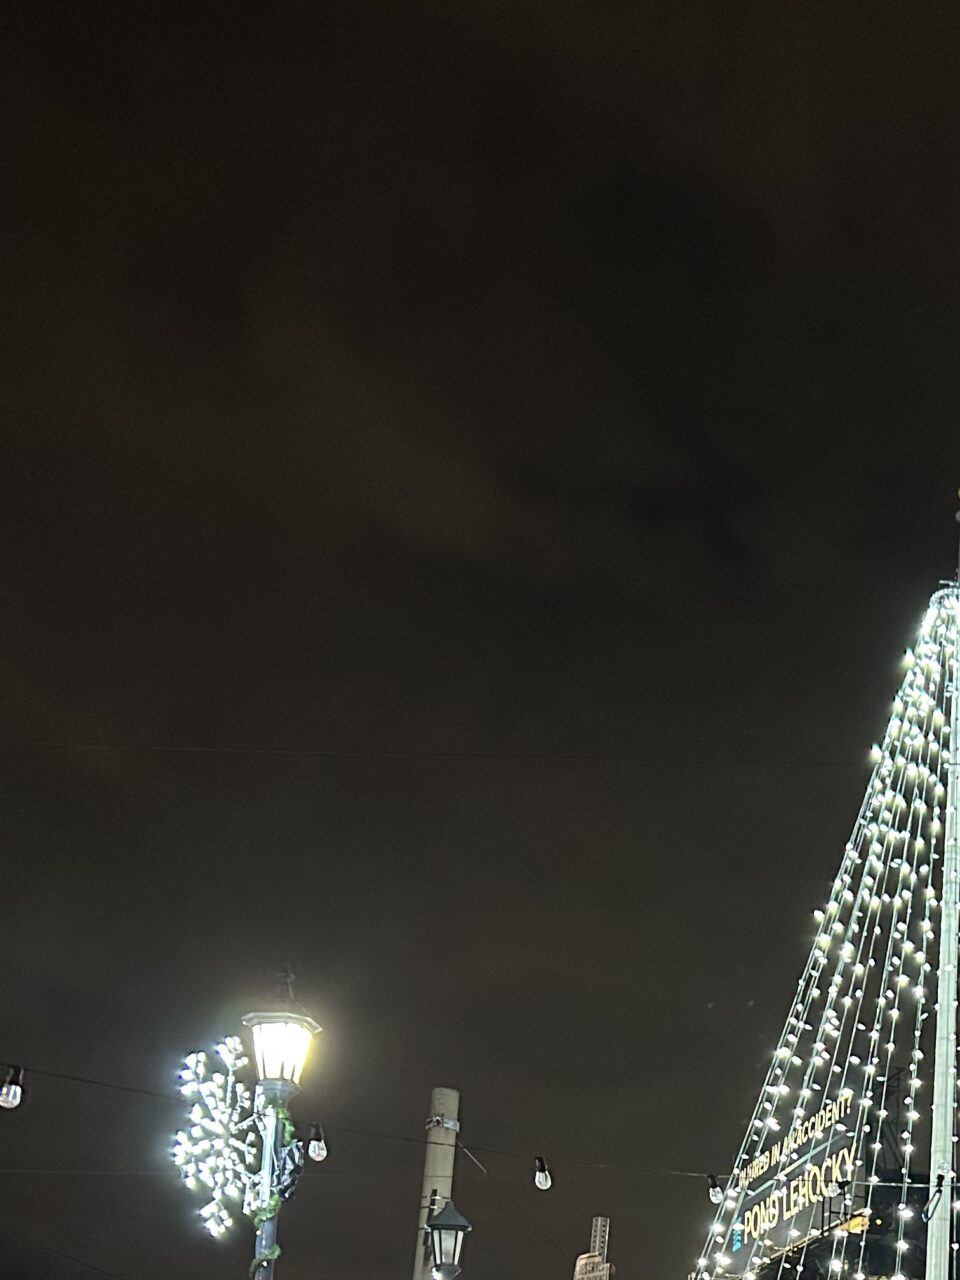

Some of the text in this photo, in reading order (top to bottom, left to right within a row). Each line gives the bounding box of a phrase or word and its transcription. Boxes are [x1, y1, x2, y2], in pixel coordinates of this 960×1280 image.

[739, 1150, 769, 1188] INJURED
[771, 1141, 781, 1166] IN
[794, 1095, 853, 1146] ACCIDENT?
[743, 1142, 857, 1244] POND LEHOCKY
